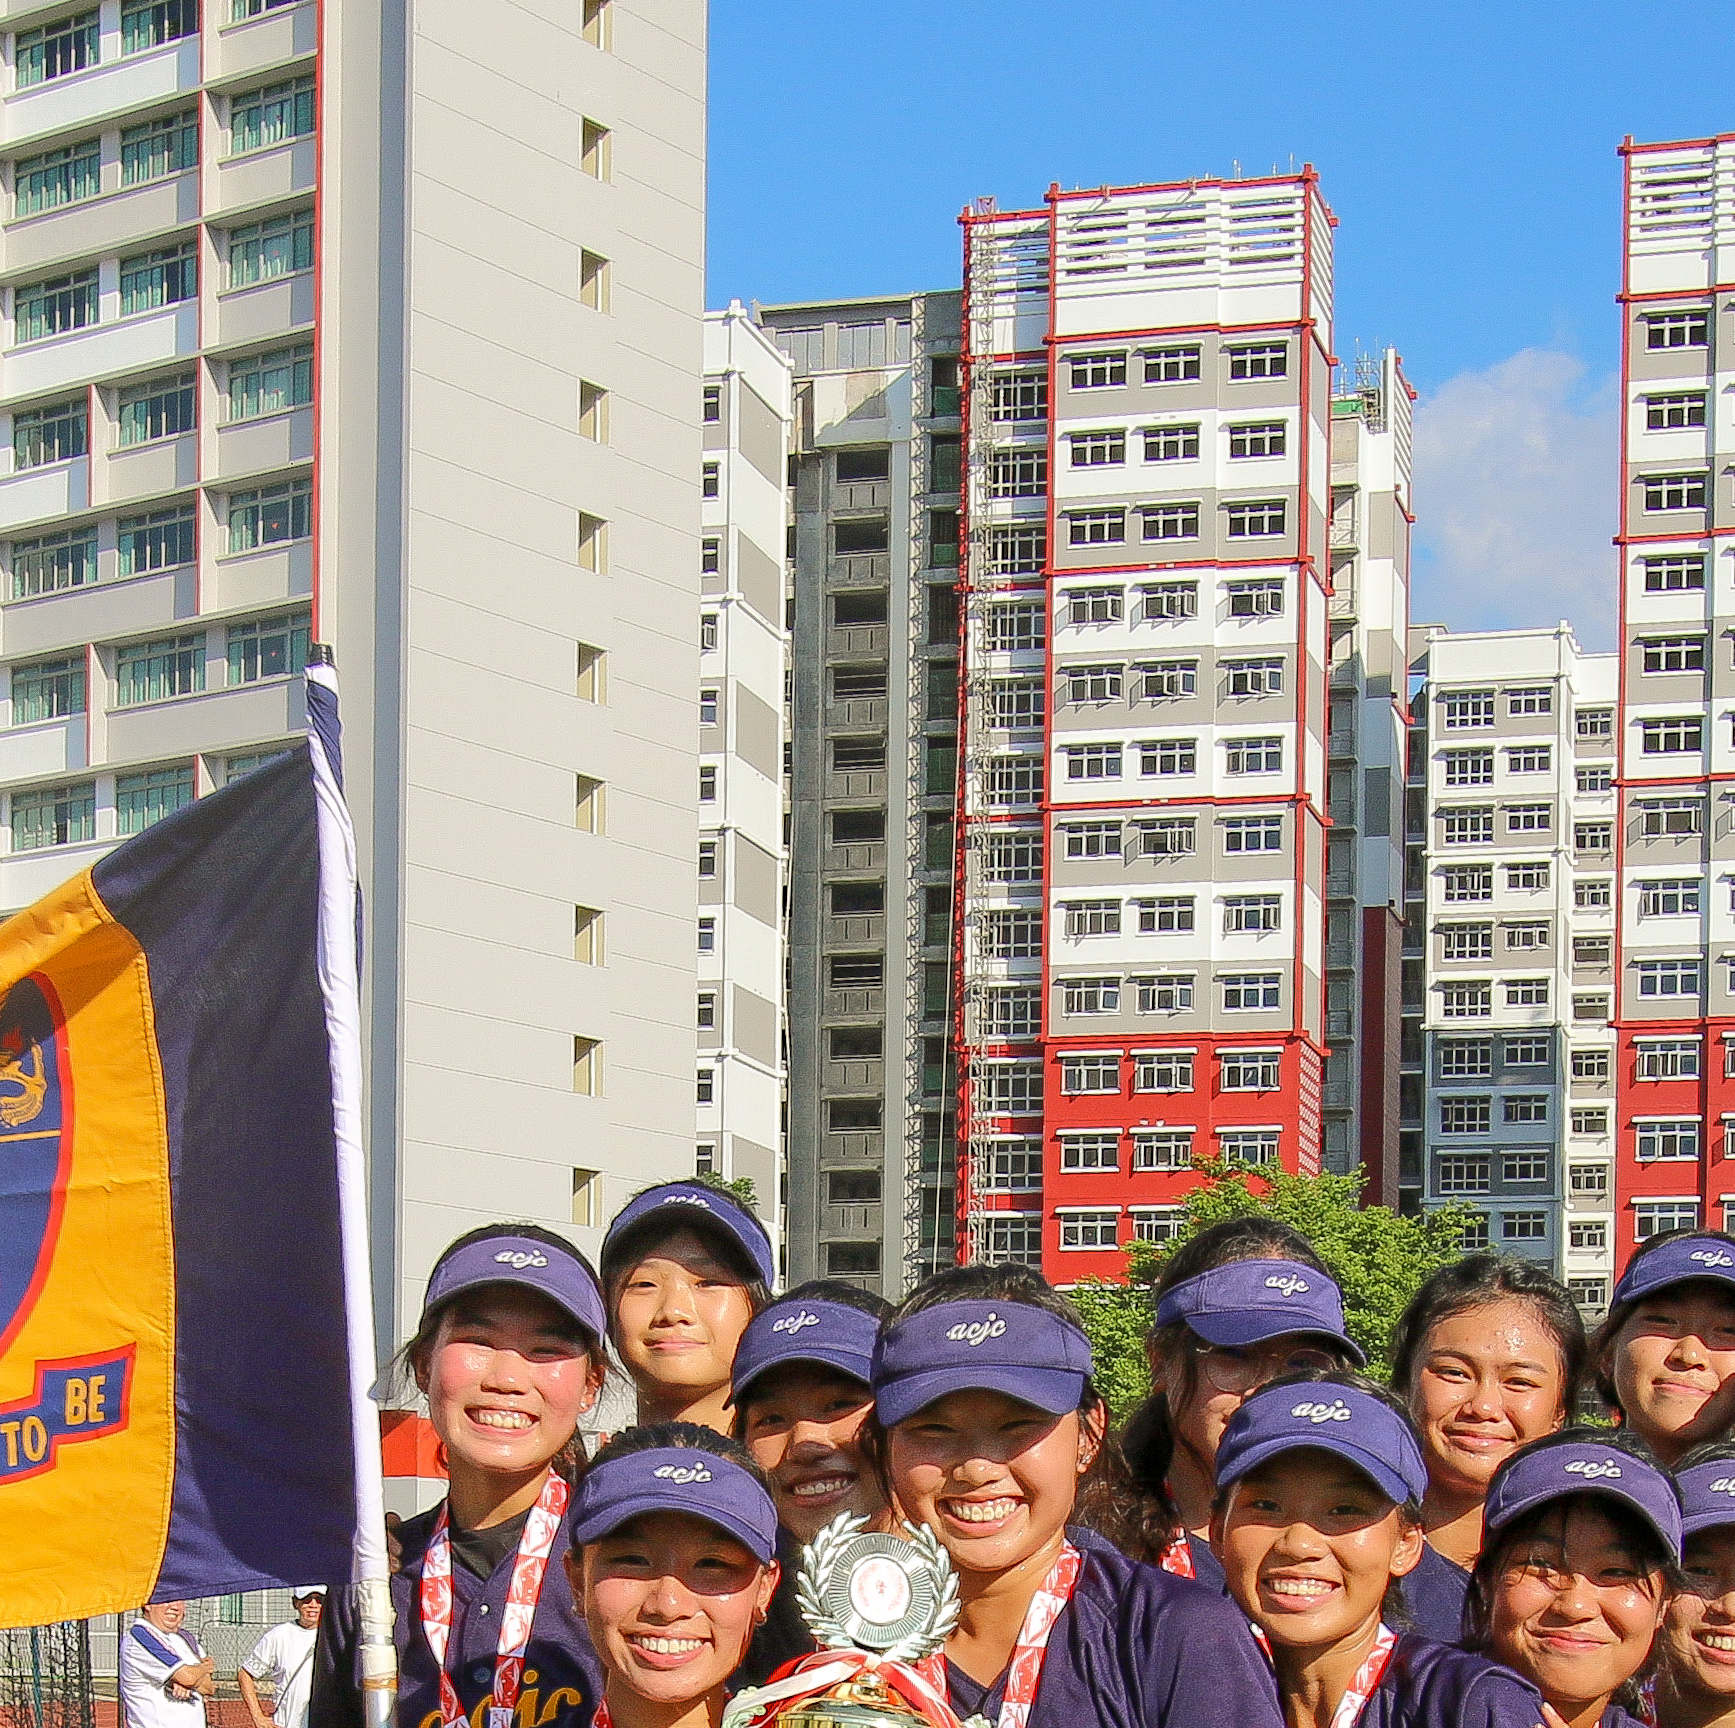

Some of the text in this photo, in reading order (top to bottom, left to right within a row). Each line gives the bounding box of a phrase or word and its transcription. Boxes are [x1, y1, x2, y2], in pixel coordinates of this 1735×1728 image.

[494, 1250, 548, 1269] acjc
[1690, 1249, 1734, 1268] acjc
[1264, 1273, 1309, 1297] acjc
[772, 1310, 820, 1335] acjc
[946, 1313, 1006, 1346] acjc
[0, 1416, 48, 1467] TO
[64, 1375, 106, 1426] BE
[1291, 1399, 1352, 1424] acjc
[653, 1462, 712, 1484] acjc
[1565, 1458, 1622, 1479] acjc
